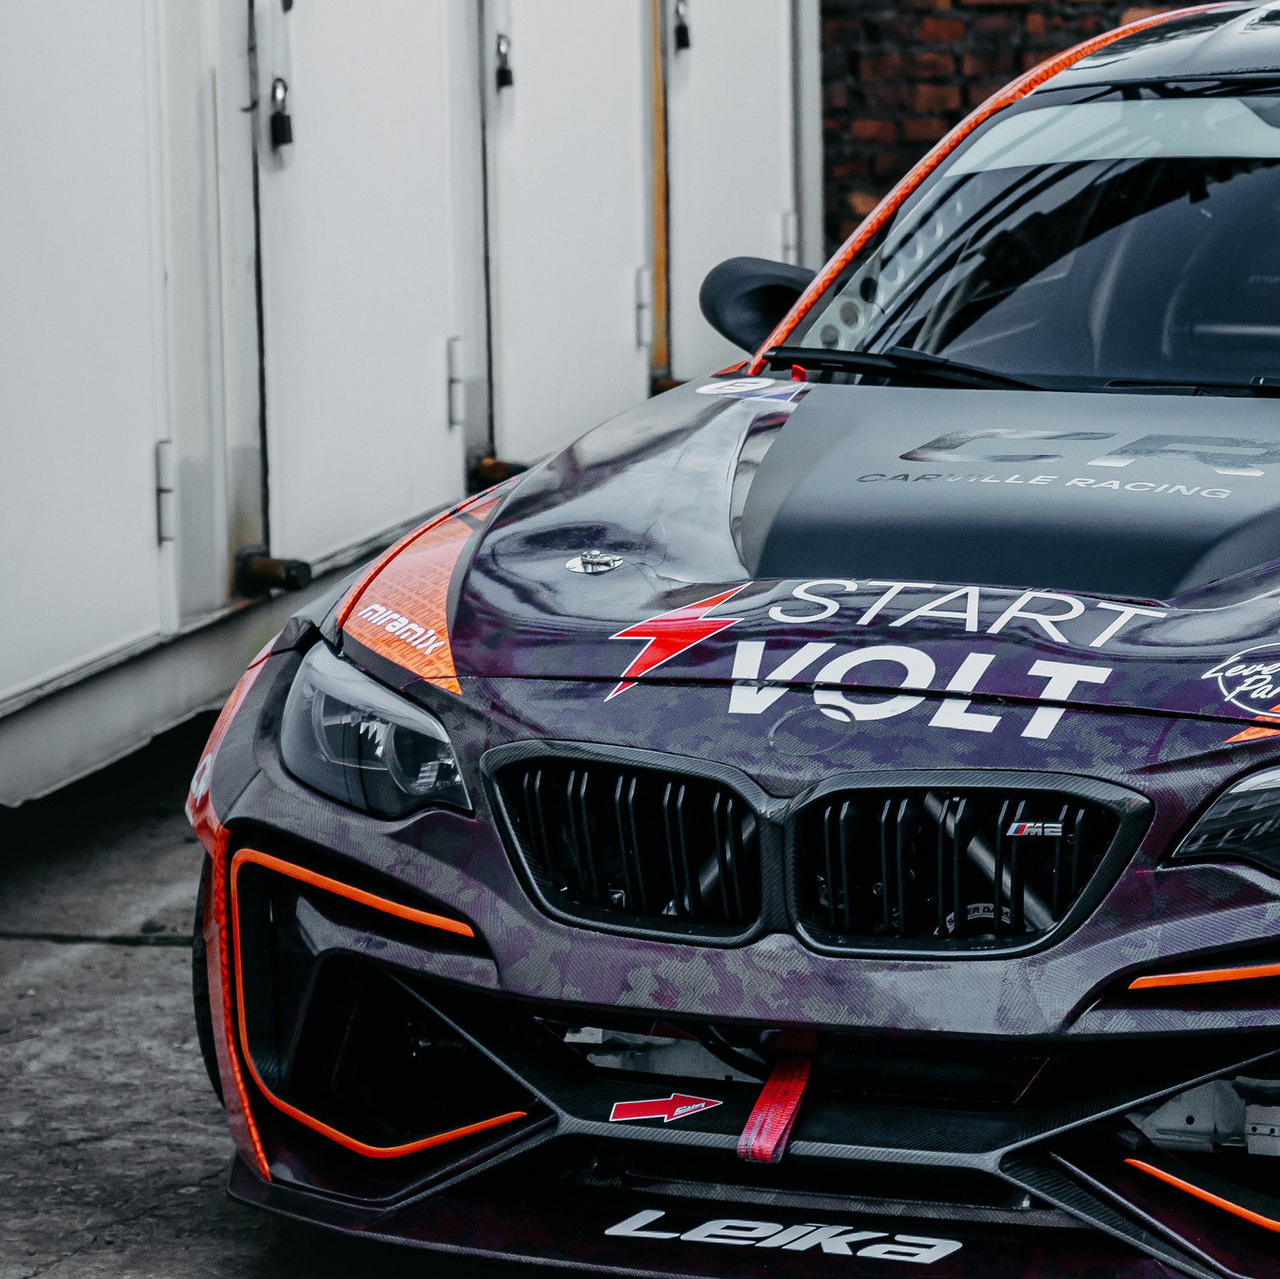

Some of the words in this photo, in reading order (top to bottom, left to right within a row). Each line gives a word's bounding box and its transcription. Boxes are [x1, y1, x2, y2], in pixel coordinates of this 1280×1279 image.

[855, 472, 1058, 486] CARVILLE
[1064, 477, 1233, 499] RACING
[357, 602, 446, 656] miramix
[768, 579, 1168, 648] START
[728, 640, 1114, 740] VOLT
[1024, 822, 1063, 837] M2
[603, 1208, 964, 1265] Leika
